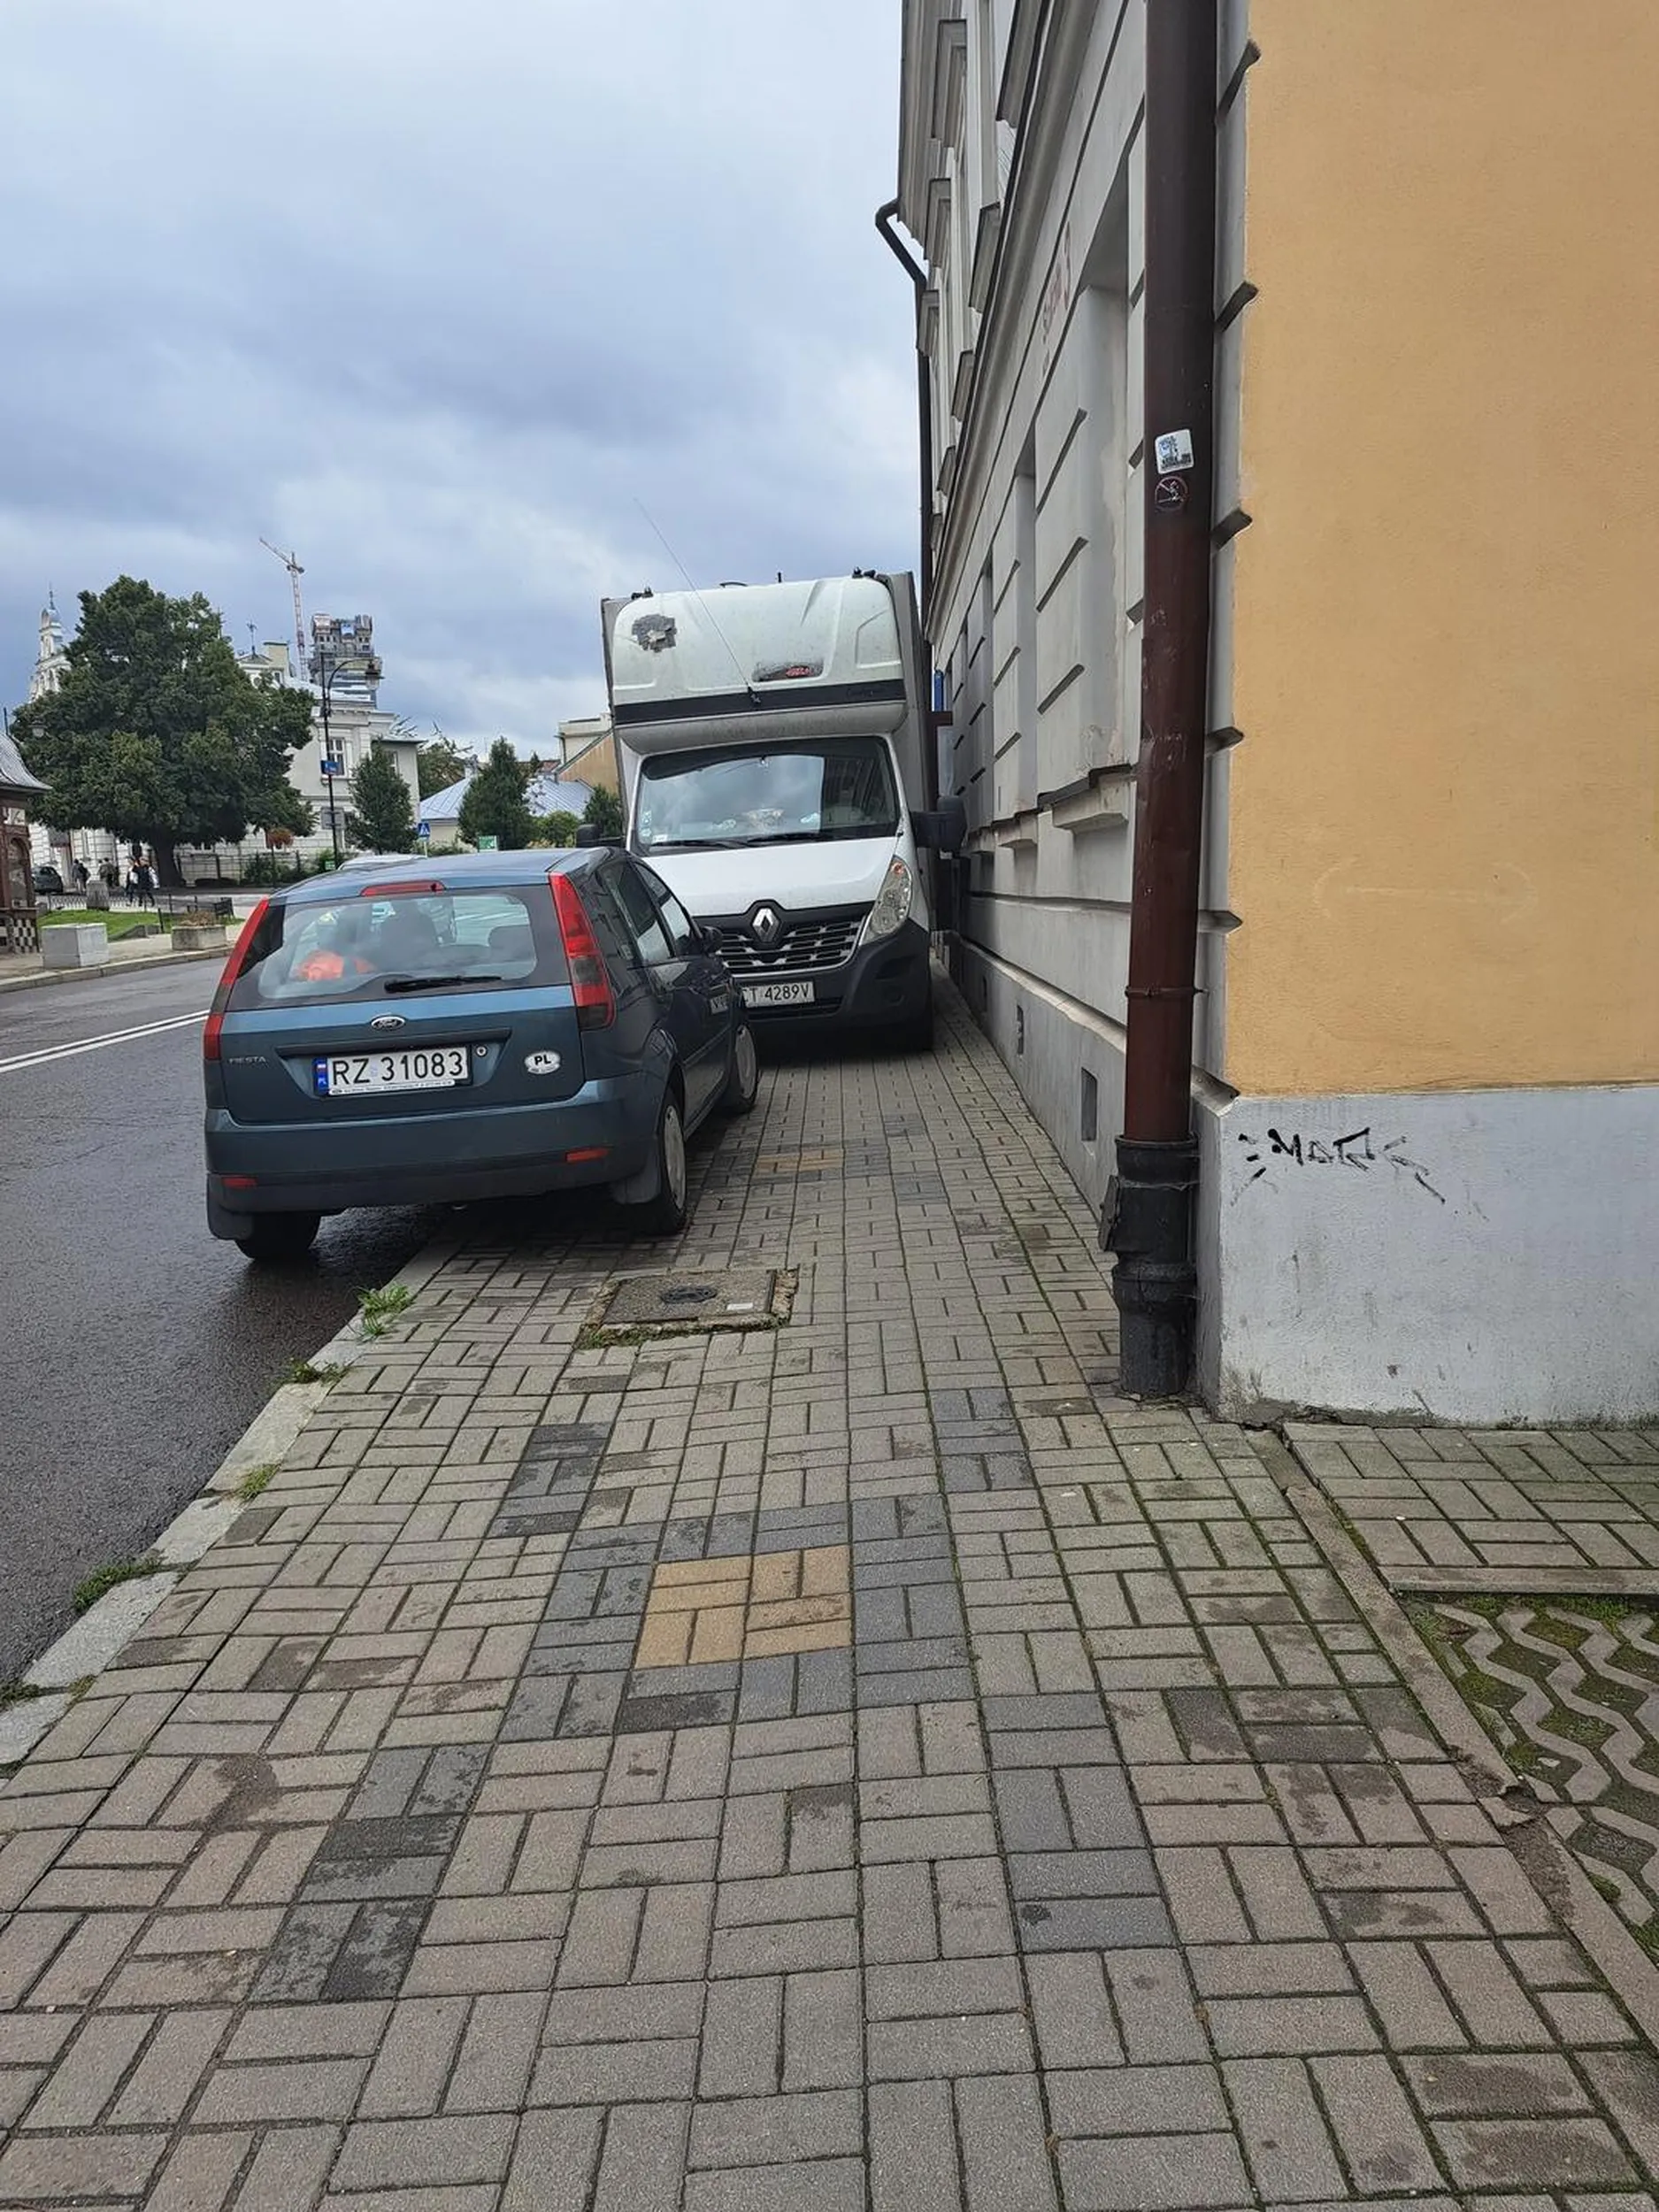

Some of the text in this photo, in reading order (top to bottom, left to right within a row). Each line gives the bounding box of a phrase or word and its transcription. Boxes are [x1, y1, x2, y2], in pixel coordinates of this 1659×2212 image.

[764, 983, 809, 1001] 4289V
[332, 1051, 463, 1086] RZ 31083
[534, 1054, 552, 1066] PL
